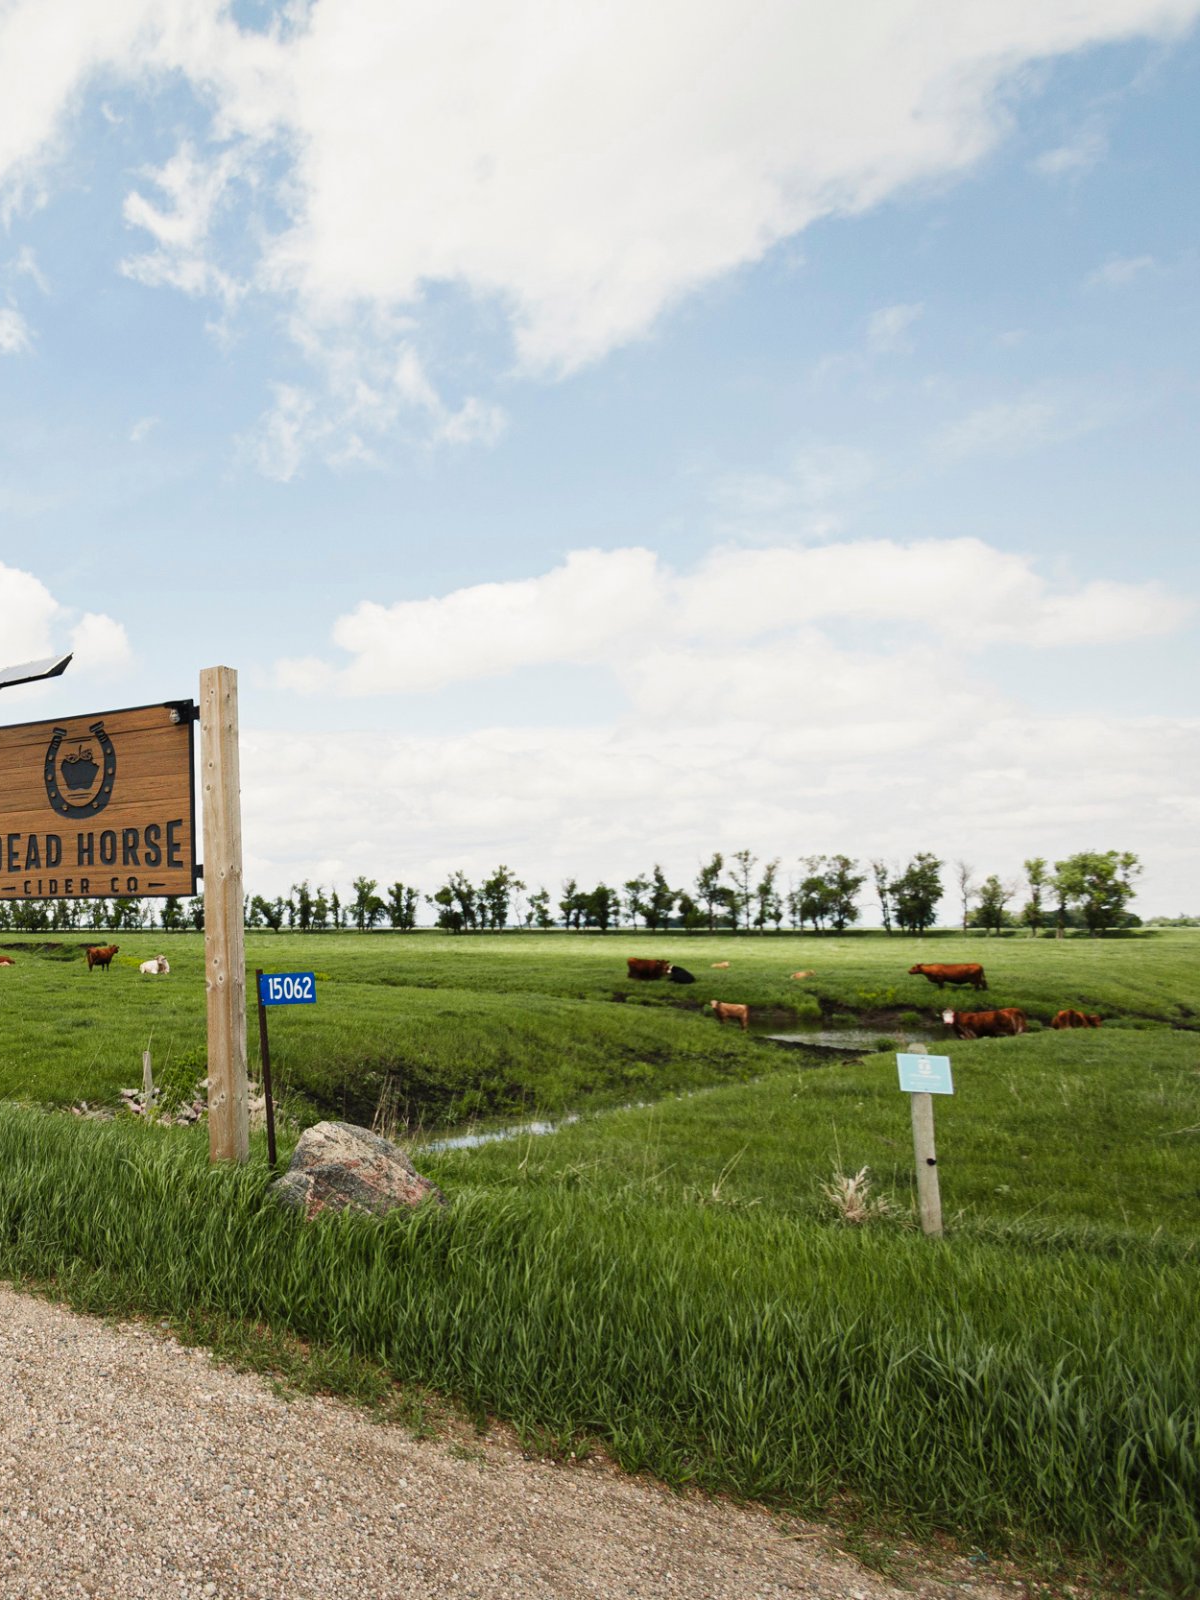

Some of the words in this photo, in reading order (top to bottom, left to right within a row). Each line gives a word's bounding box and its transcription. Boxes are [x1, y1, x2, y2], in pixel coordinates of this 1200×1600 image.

[77, 818, 184, 868] HORSE
[23, 878, 90, 895] CIDER
[110, 876, 138, 893] CO
[268, 976, 313, 1000] 15062
